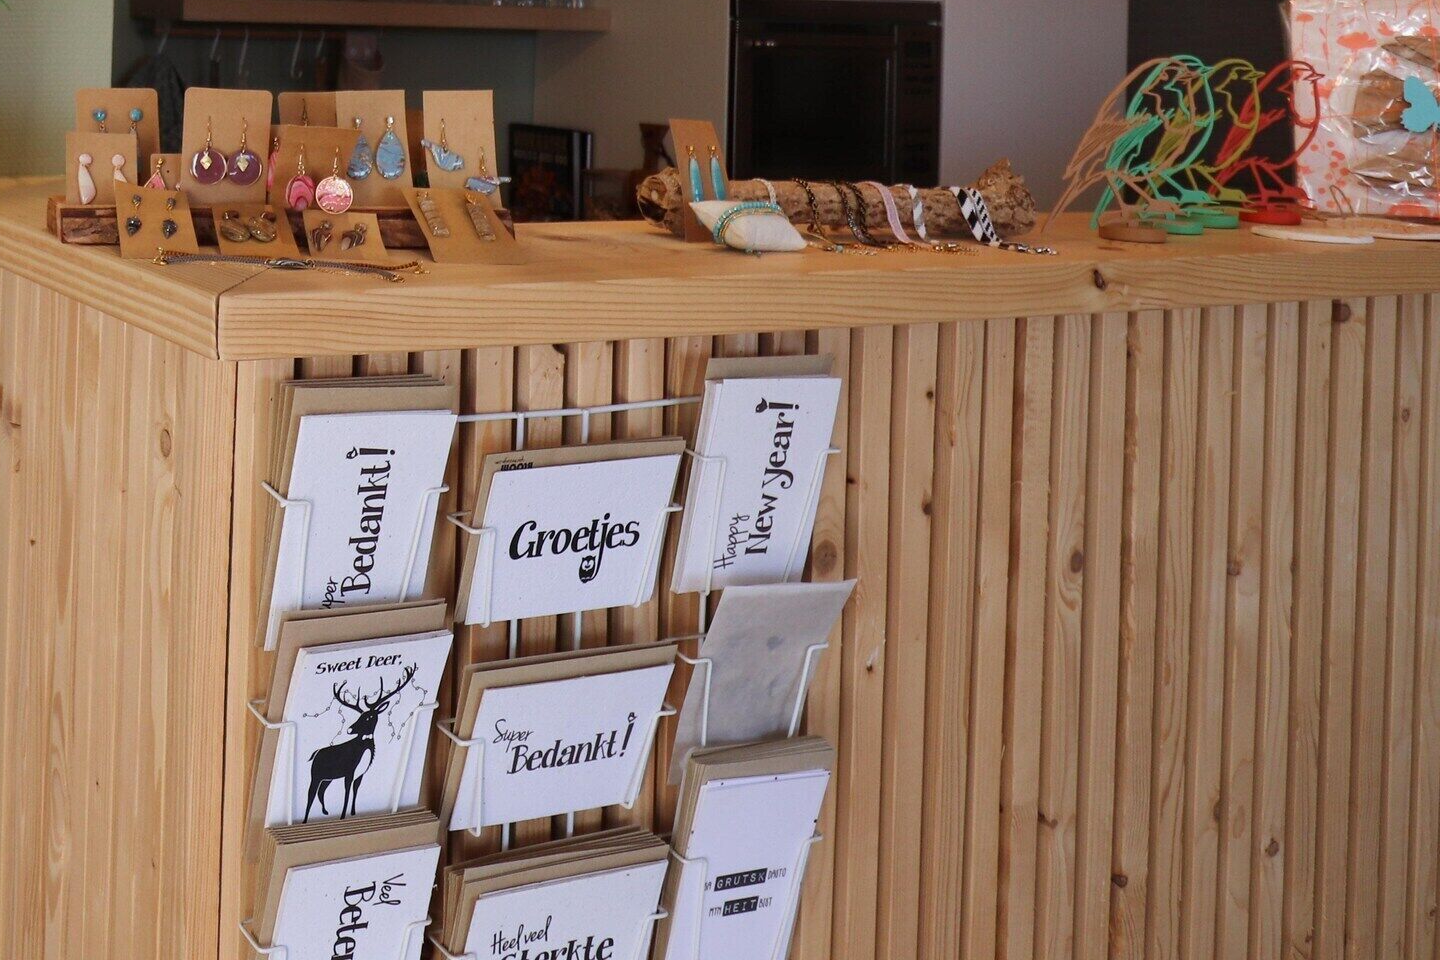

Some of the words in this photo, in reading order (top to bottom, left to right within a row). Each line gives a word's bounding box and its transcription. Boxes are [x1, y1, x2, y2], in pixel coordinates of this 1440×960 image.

[339, 446, 396, 598] Bedankt!
[744, 492, 779, 556] New
[508, 512, 641, 582] Groetjes
[713, 512, 750, 570] Happy
[320, 576, 345, 610] uper
[315, 657, 362, 675] Sweet
[492, 717, 535, 754] Super
[506, 721, 636, 775] Bedankt!
[371, 872, 407, 907] Veel
[715, 870, 767, 890] GRUTSK
[723, 898, 758, 915] HEIT
[490, 923, 525, 955] Heel
[524, 914, 553, 942] veel
[501, 935, 615, 960] rkte
